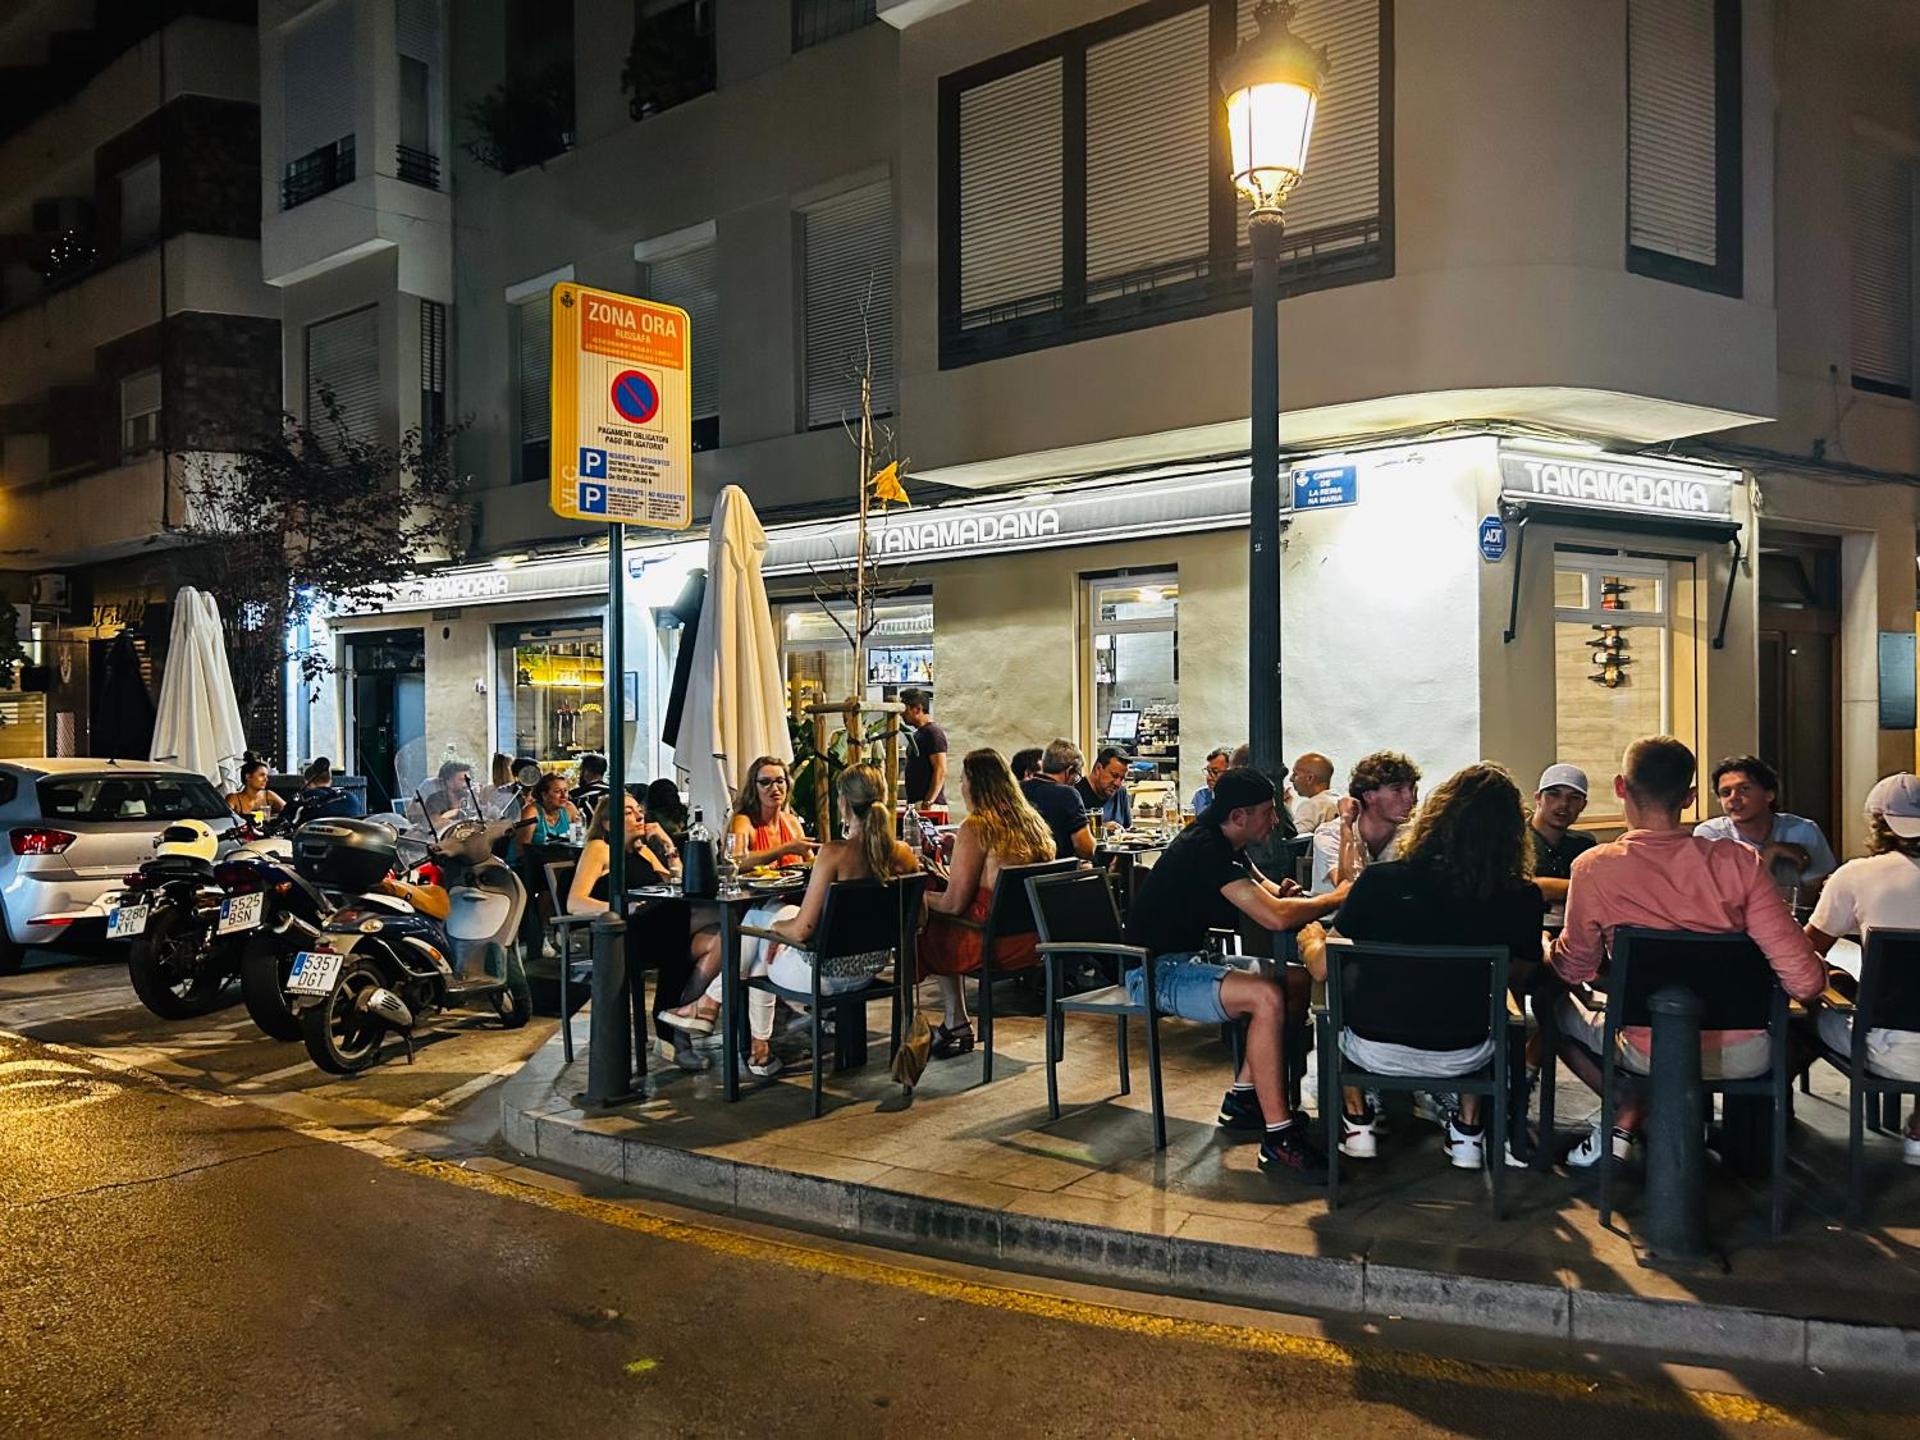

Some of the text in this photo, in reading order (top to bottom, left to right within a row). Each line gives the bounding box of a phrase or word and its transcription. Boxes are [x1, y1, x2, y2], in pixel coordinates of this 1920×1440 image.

[588, 301, 677, 338] ZONA ORA
[597, 426, 669, 444] PAGAMENT OBLIGATORI
[605, 435, 664, 451] PAGO OBLIGATORIO
[561, 464, 579, 509] VLC
[1308, 489, 1319, 497] LA
[1524, 462, 1710, 512] TANAMADANA
[871, 508, 1060, 554] TANAMADANA
[1483, 528, 1503, 544] ADT
[405, 574, 509, 602] NAMADANA
[230, 895, 260, 912] 5525
[119, 906, 146, 922] 5280
[228, 910, 252, 926] BSN
[304, 954, 339, 972] 5351
[297, 971, 326, 988] DGT
